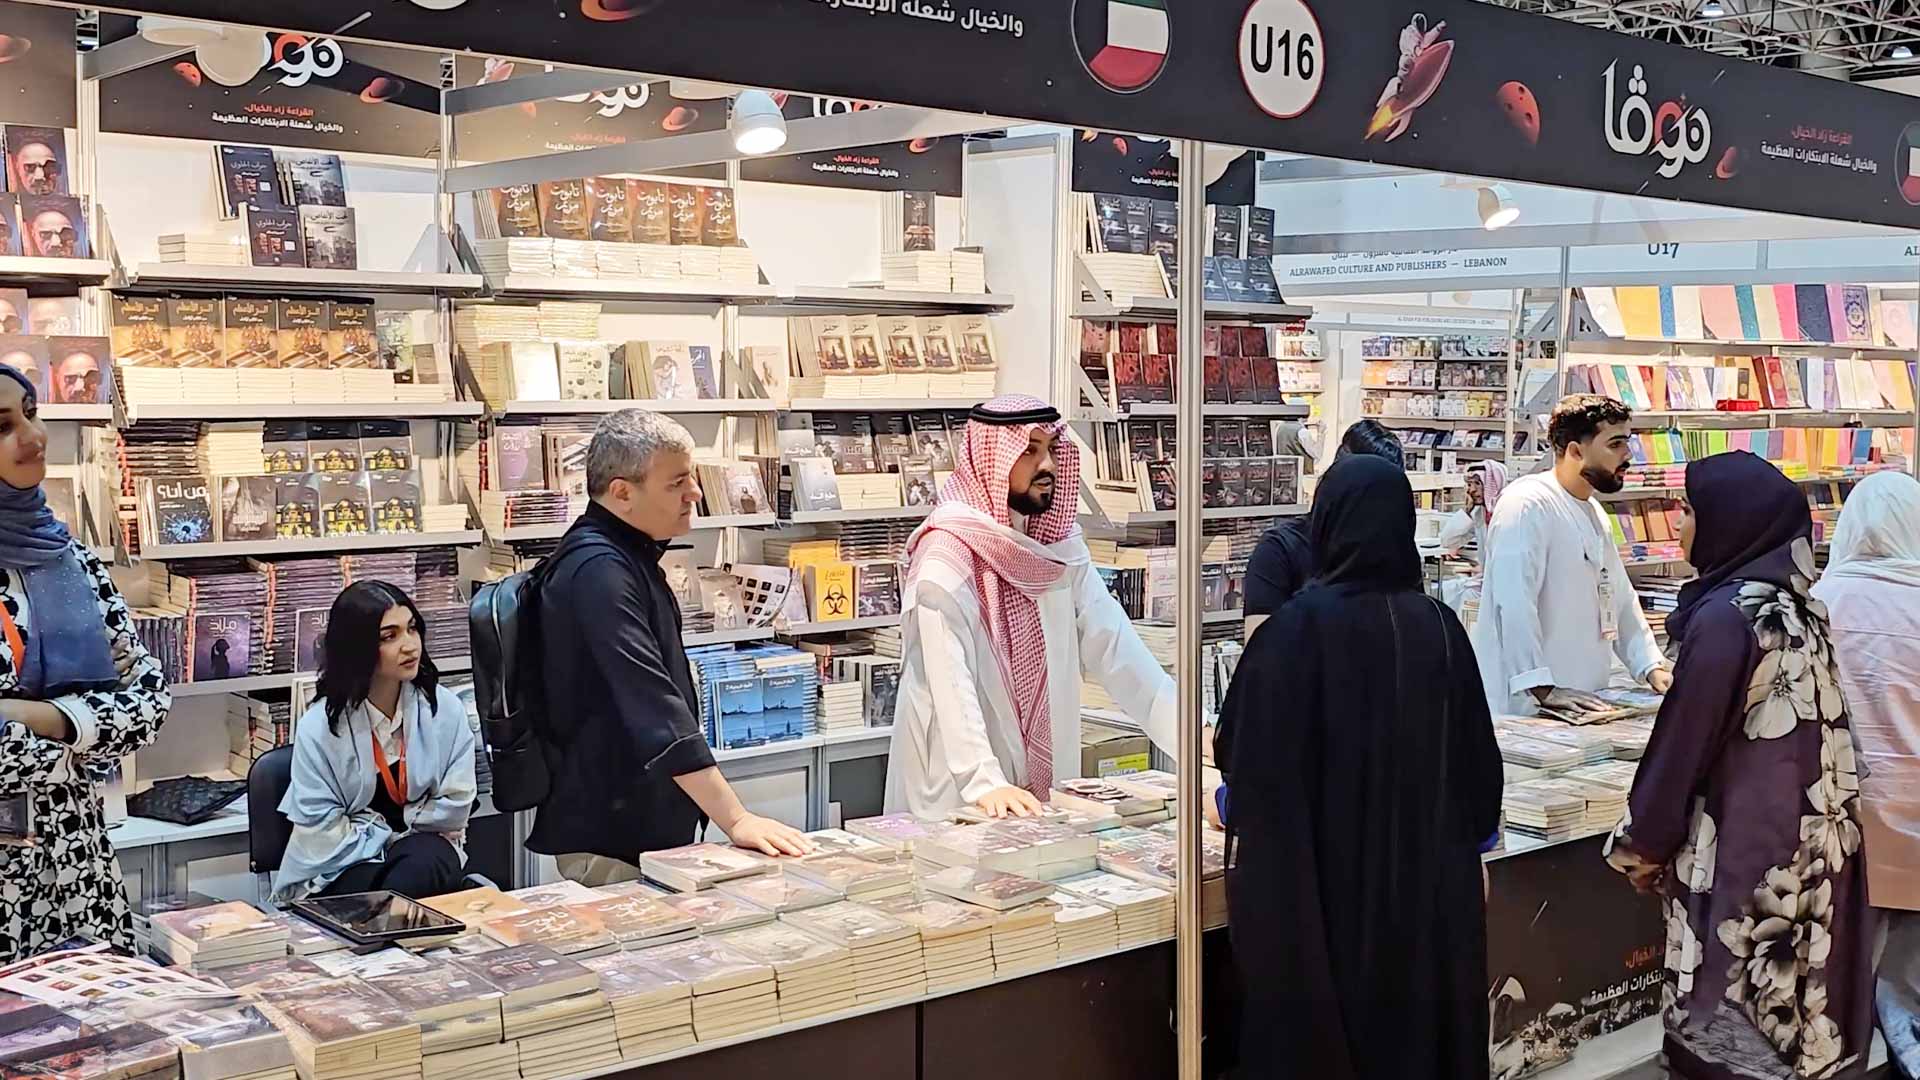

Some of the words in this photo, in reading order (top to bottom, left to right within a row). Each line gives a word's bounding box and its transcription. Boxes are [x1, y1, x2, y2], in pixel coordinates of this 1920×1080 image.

[961, 9, 1024, 37] والخيال
[1250, 24, 1314, 80] U16
[1761, 140, 1794, 159] العظيمة
[1795, 148, 1829, 166] الابتكارات
[1829, 153, 1852, 168] شعلة
[1648, 242, 1680, 259] U17
[1289, 266, 1337, 277] ALRAWAFED
[1337, 264, 1375, 274] CULTURE
[1375, 262, 1395, 273] AND
[1395, 260, 1448, 272] PUBLISHERS
[1463, 257, 1508, 268] LEBANON
[210, 616, 237, 633] ملاذ
